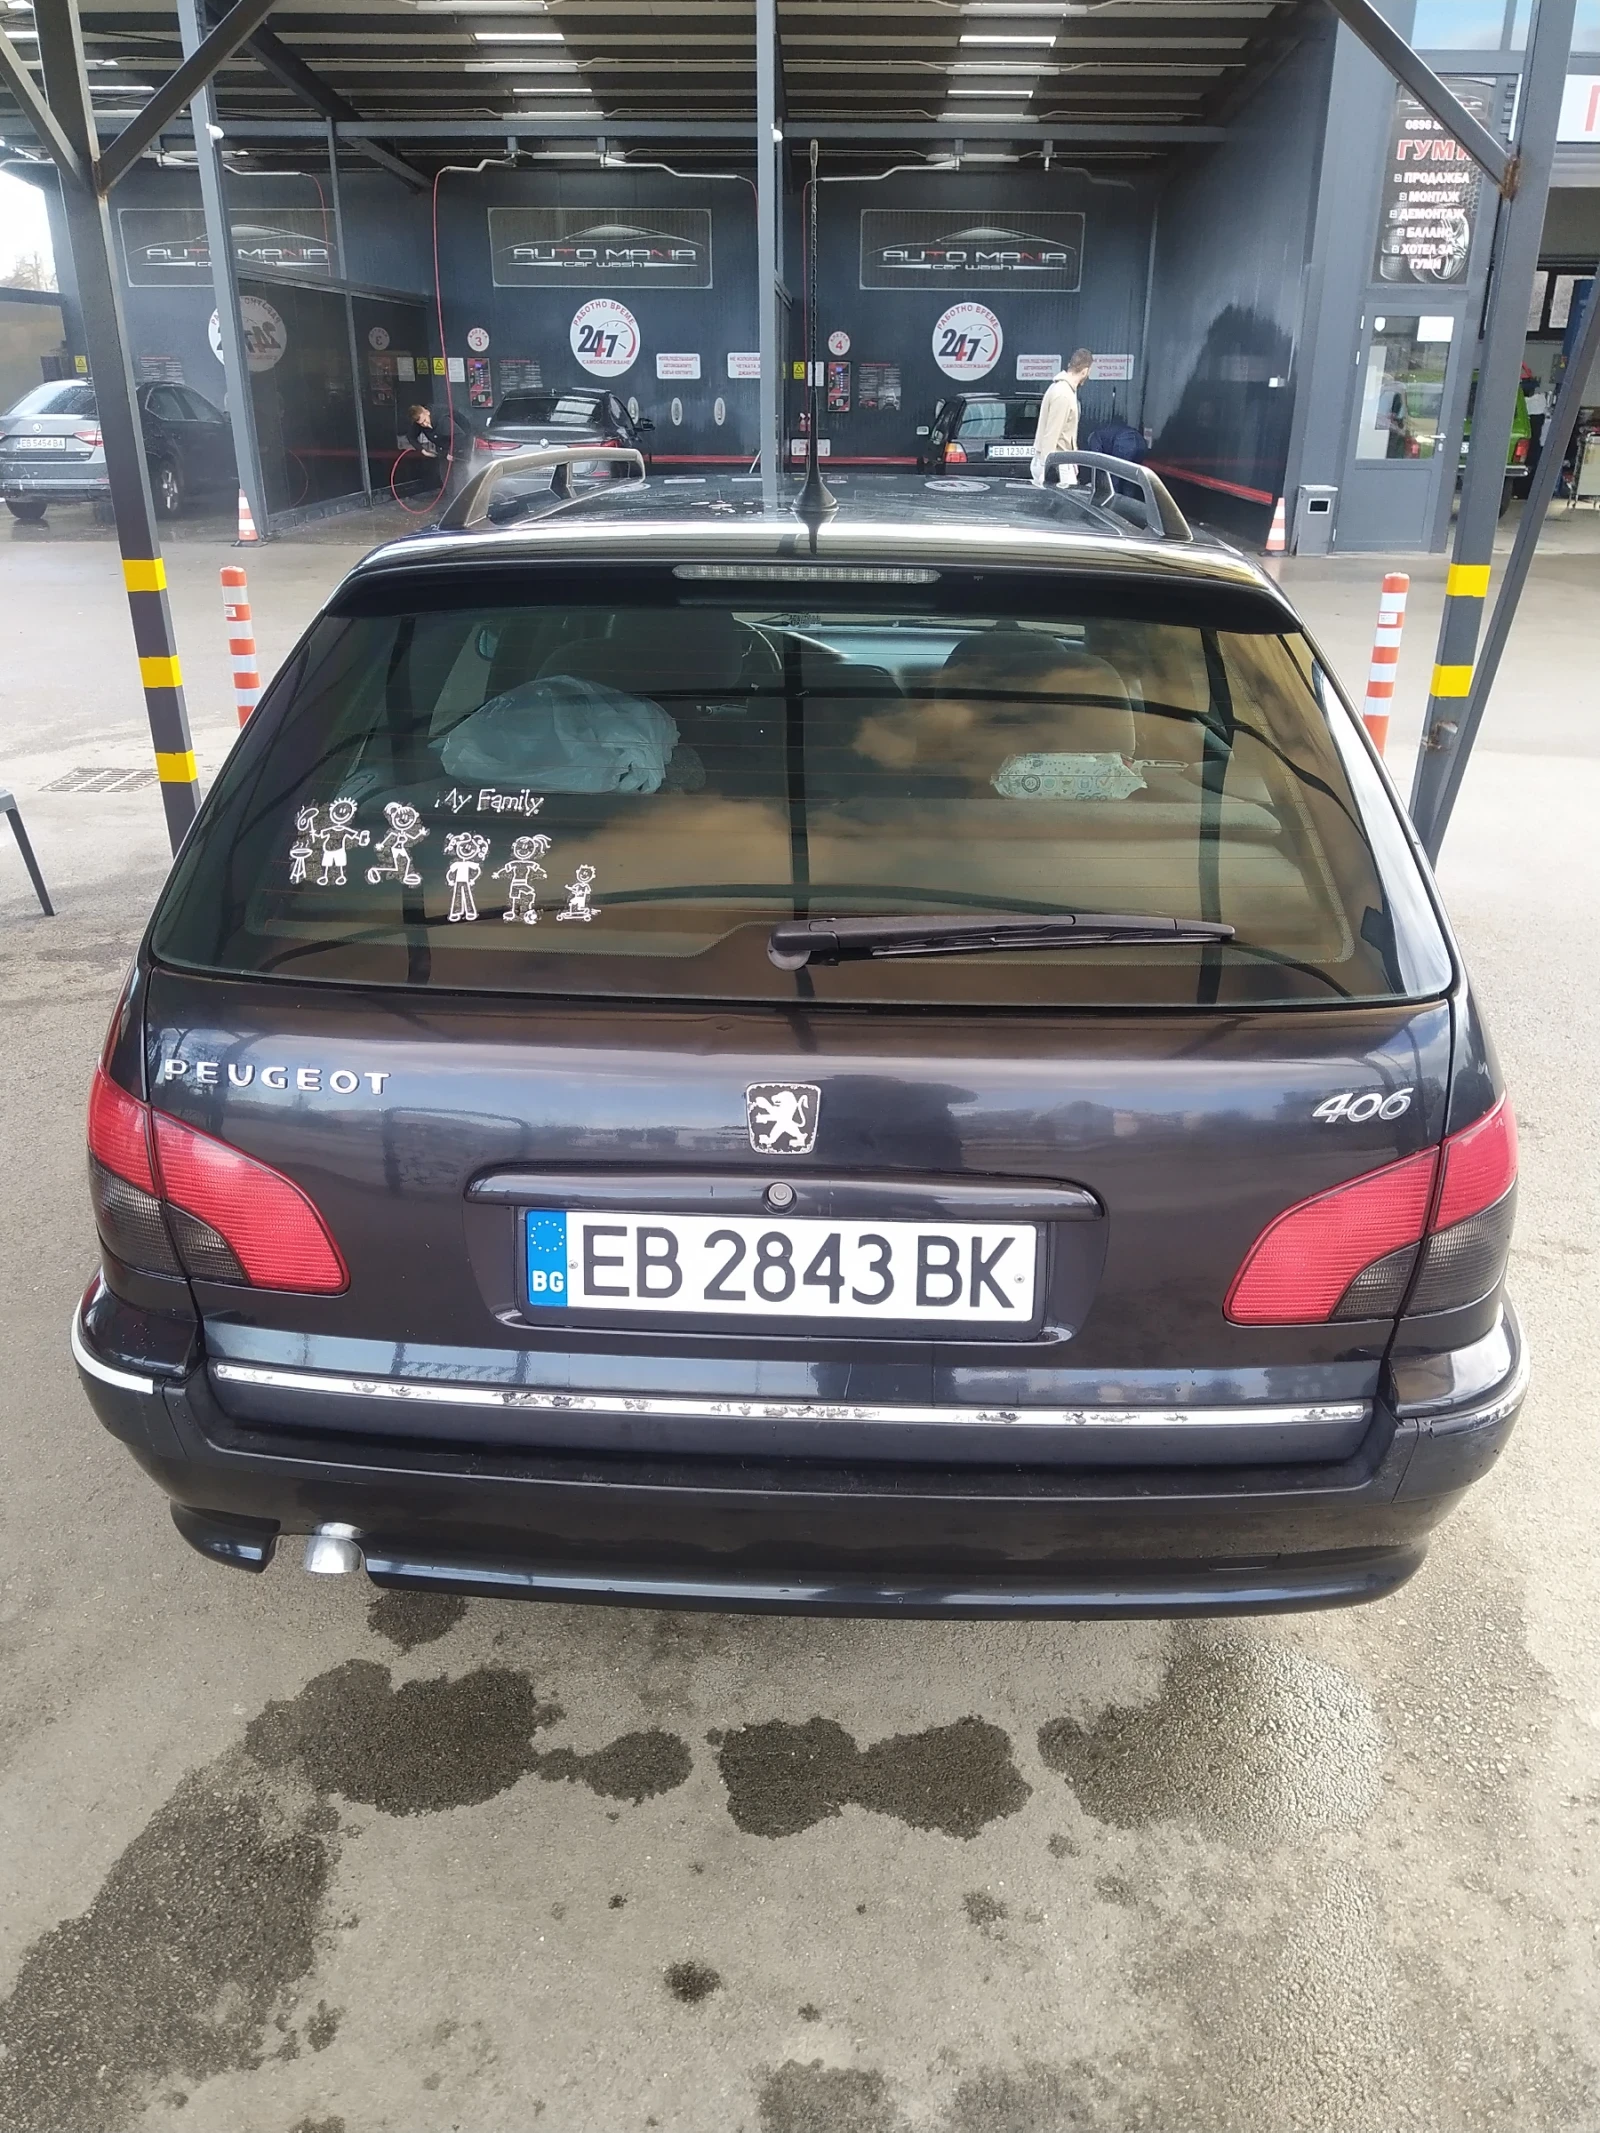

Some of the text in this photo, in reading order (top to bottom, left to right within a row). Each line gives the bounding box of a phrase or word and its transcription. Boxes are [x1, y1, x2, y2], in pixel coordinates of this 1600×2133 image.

[1403, 172, 1470, 185] ПРОДАЖБА
[1408, 191, 1460, 203] МОНТАЖ
[1398, 208, 1465, 221] ДЕМОНТАЖ
[1406, 227, 1452, 238] БАЛАНС
[146, 248, 328, 260] AUT MANIA
[513, 248, 696, 261] AUTO MANIA
[1400, 244, 1454, 255] ХОТЕЛ ЗА
[596, 260, 644, 268] wash
[883, 251, 1067, 264] AUTO MANIA
[1409, 258, 1442, 270] ГУМИ
[965, 263, 1013, 271] wash
[573, 300, 636, 327] РАБОТНО ВРЕМЕ
[937, 304, 1000, 331] РАБОТНО ВРЕМЕ
[475, 336, 482, 347] 3
[835, 340, 843, 350] 4
[476, 787, 544, 817] Family
[164, 1058, 391, 1096] PEUGEOT
[1311, 1087, 1414, 1123] 406
[702, 1228, 896, 1306] 2843
[532, 1269, 565, 1294] BG
